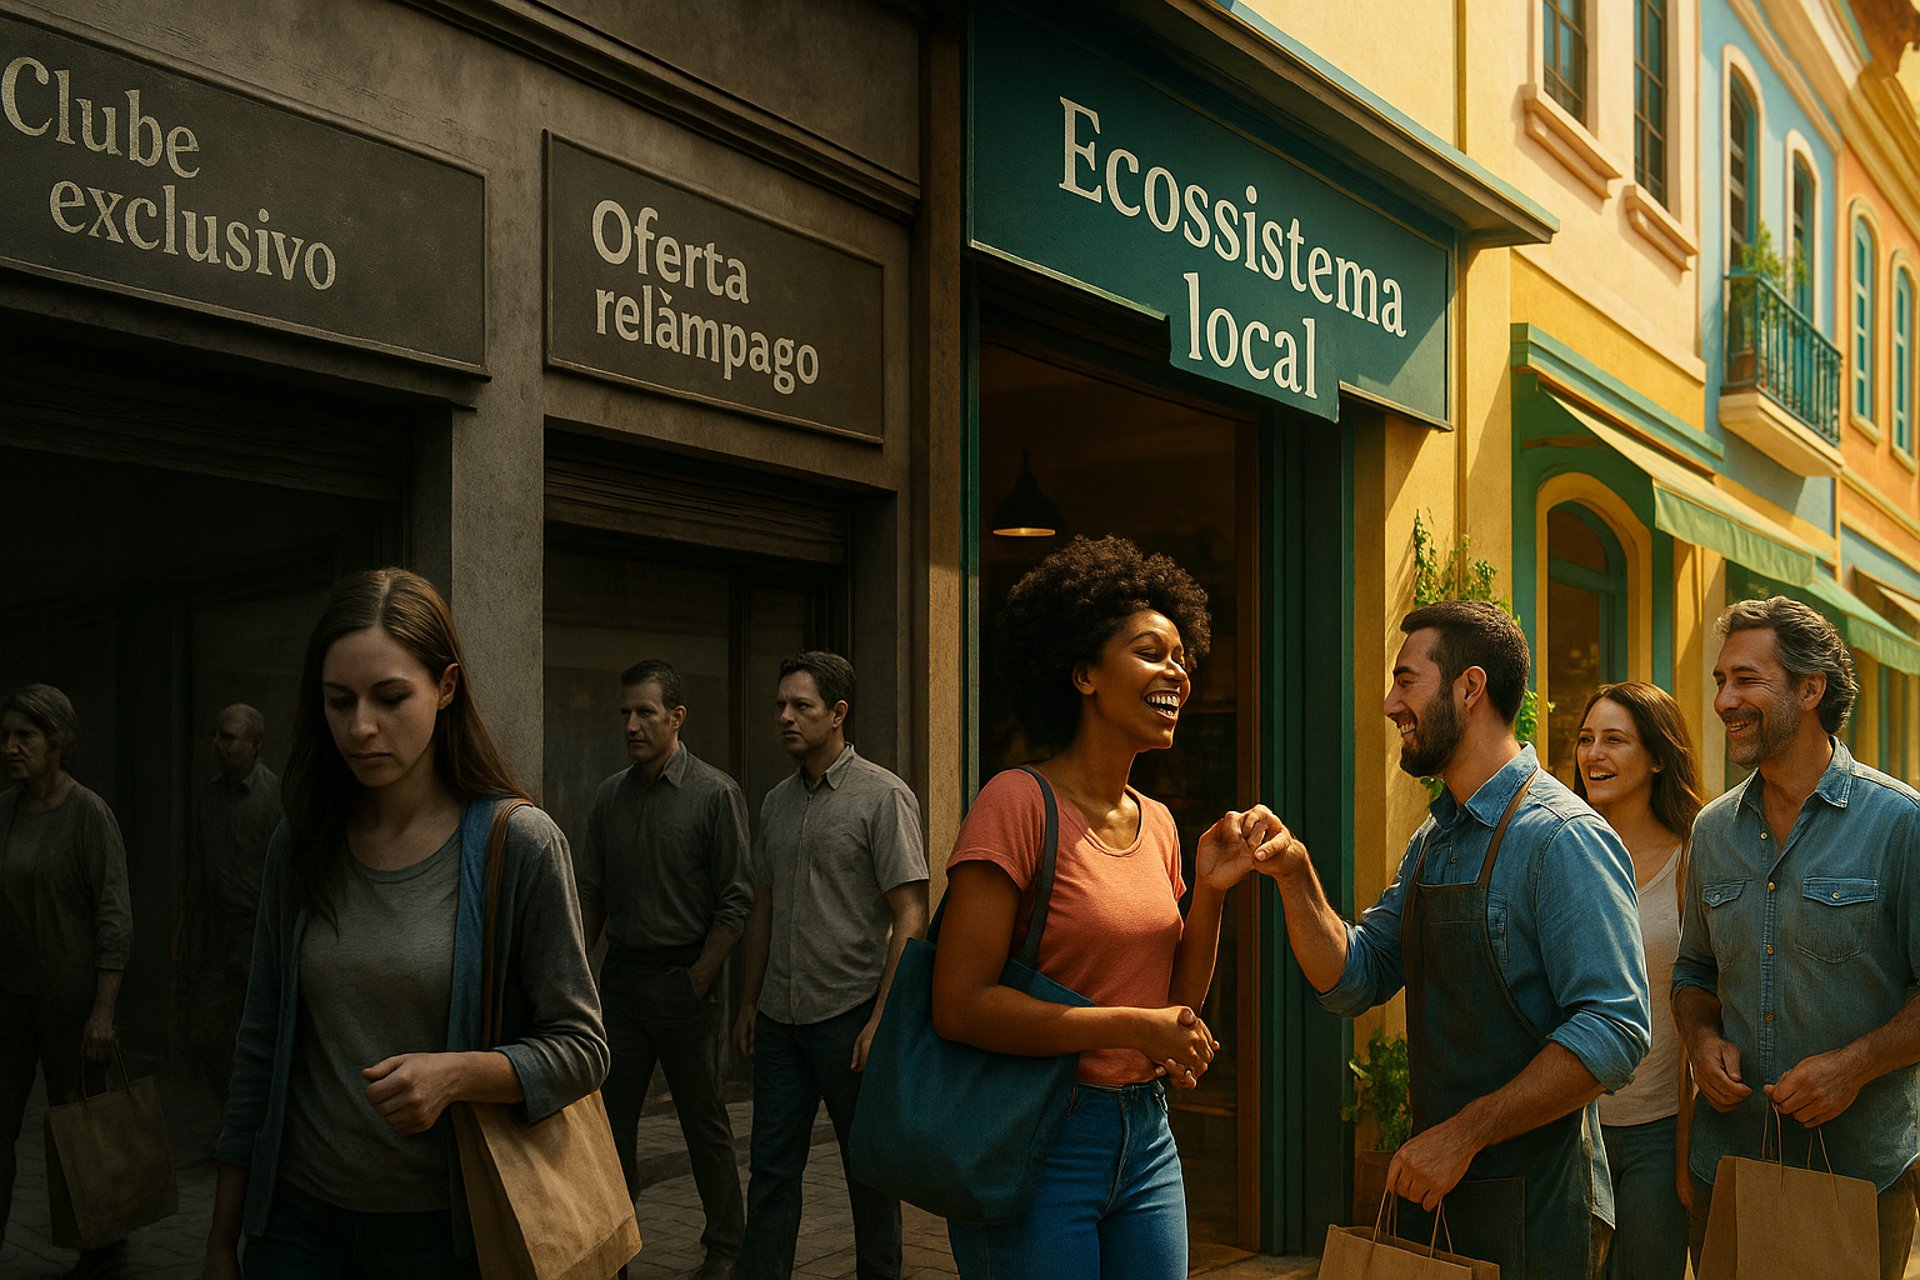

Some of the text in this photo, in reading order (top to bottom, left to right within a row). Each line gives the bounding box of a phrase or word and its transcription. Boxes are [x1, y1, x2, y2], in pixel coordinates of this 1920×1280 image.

[1, 56, 200, 179] Clube
[49, 181, 337, 290] exclusivo
[592, 200, 749, 304] Oferta
[1059, 96, 1406, 337] Ecossistema
[1183, 272, 1317, 399] local
